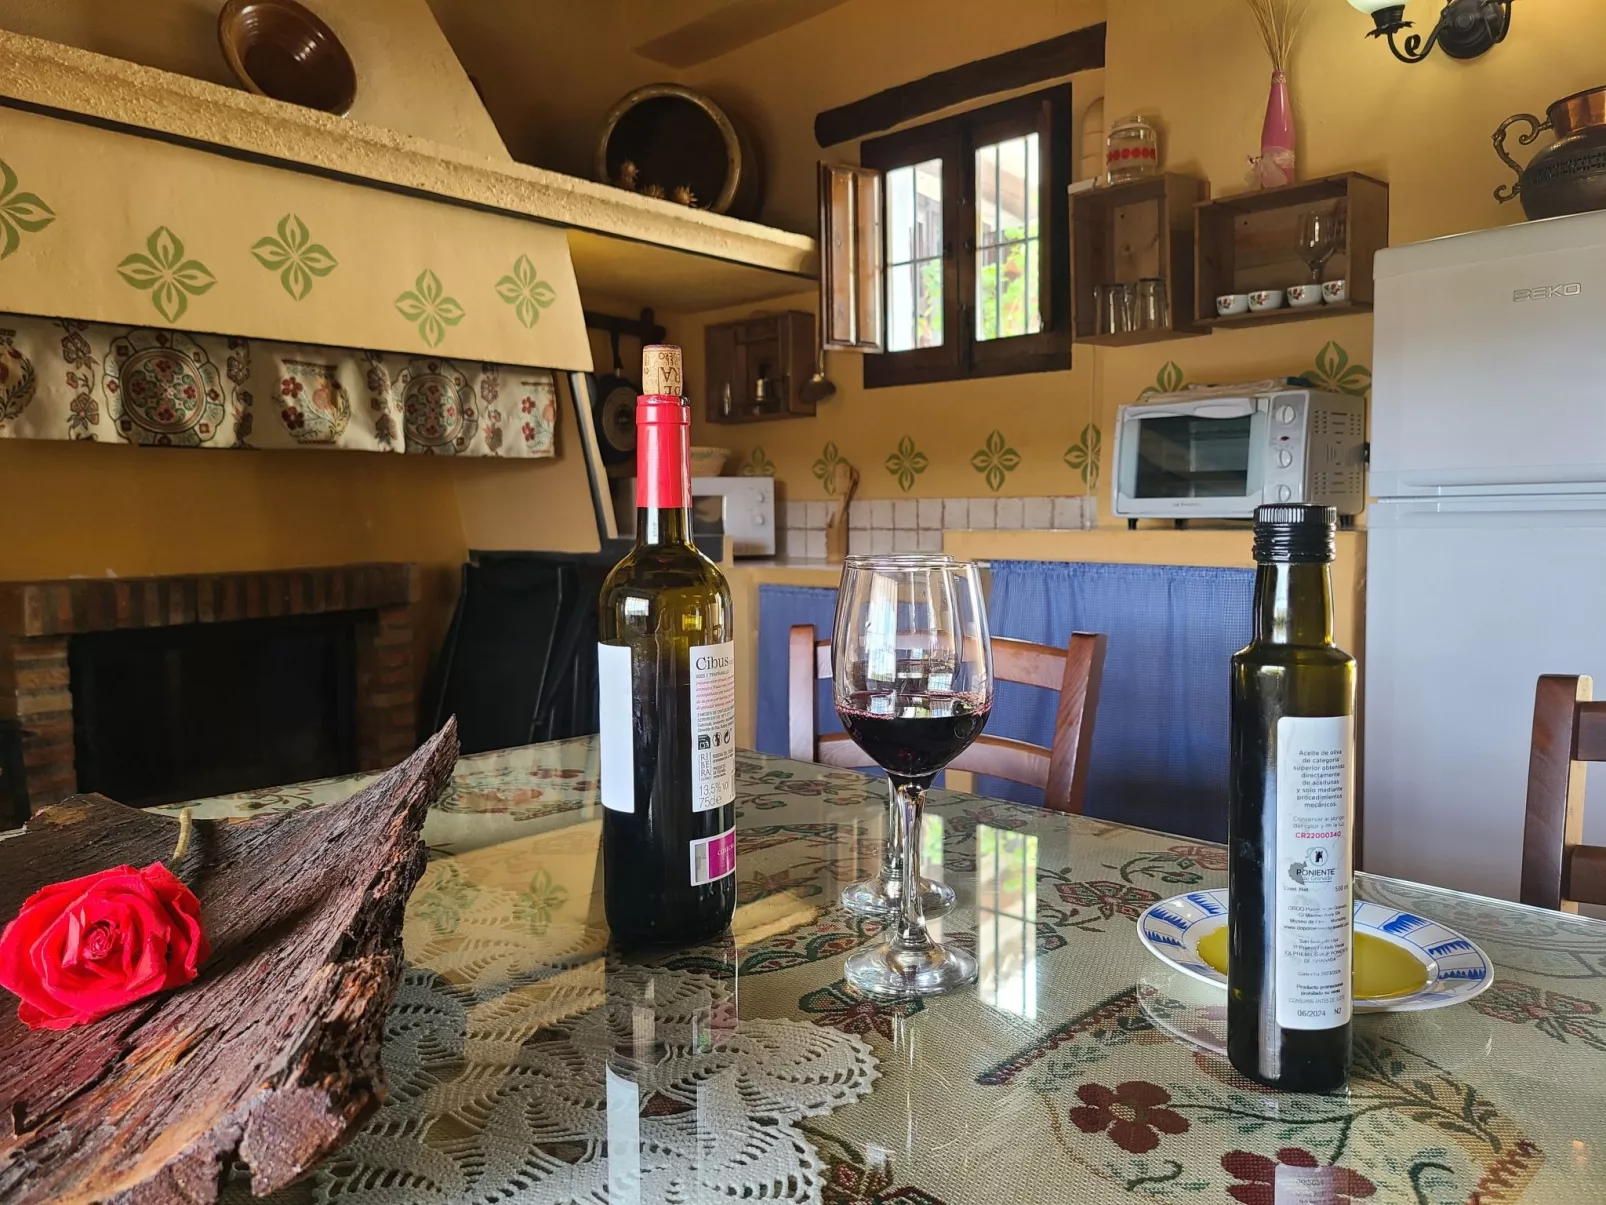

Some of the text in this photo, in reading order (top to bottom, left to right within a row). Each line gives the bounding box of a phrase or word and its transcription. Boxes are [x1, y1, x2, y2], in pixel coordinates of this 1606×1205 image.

[1513, 283, 1581, 302] BEKO
[696, 656, 728, 670] Cibus
[1295, 831, 1342, 839] CR22000340
[1296, 868, 1336, 876] PONIENTE
